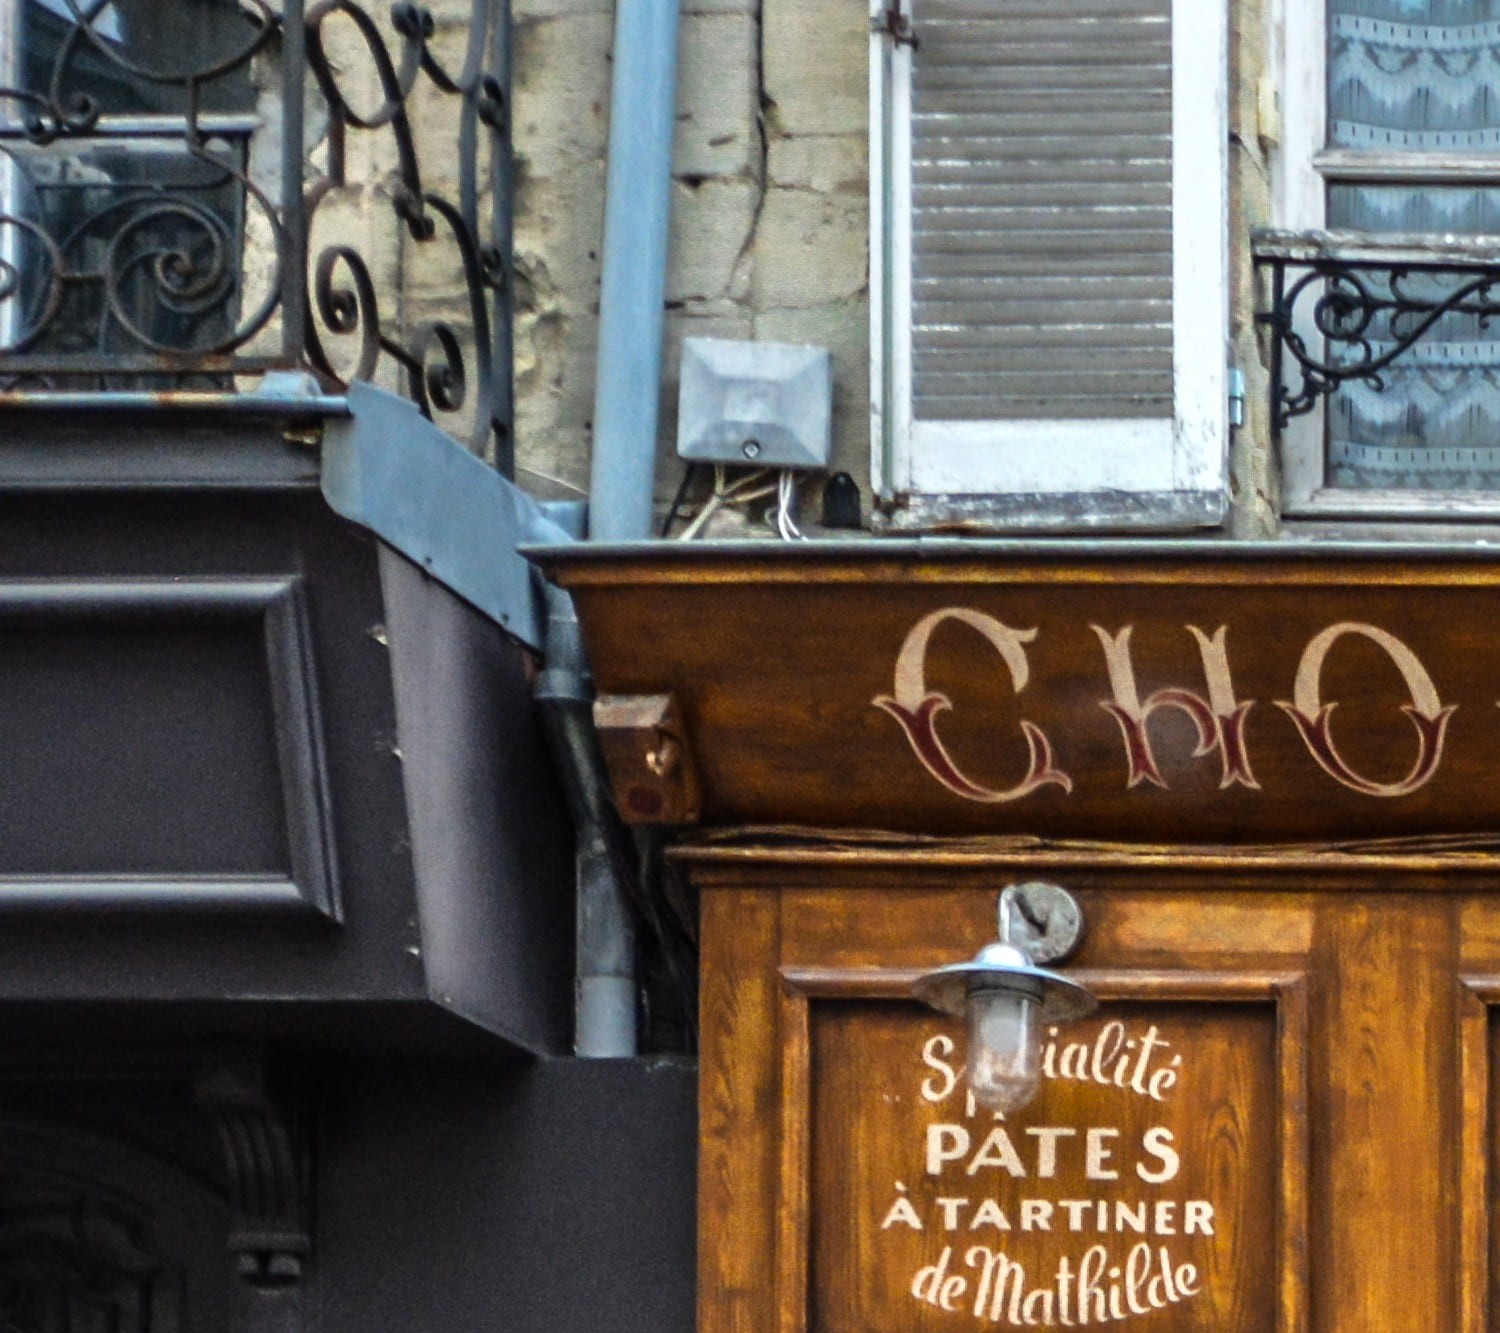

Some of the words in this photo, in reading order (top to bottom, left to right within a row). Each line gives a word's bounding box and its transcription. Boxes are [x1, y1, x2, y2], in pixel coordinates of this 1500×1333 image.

[881, 1181, 922, 1230] À
[936, 1196, 1217, 1236] TARTINER
[911, 1246, 968, 1312] de
[966, 1241, 1202, 1327] Mathilde
